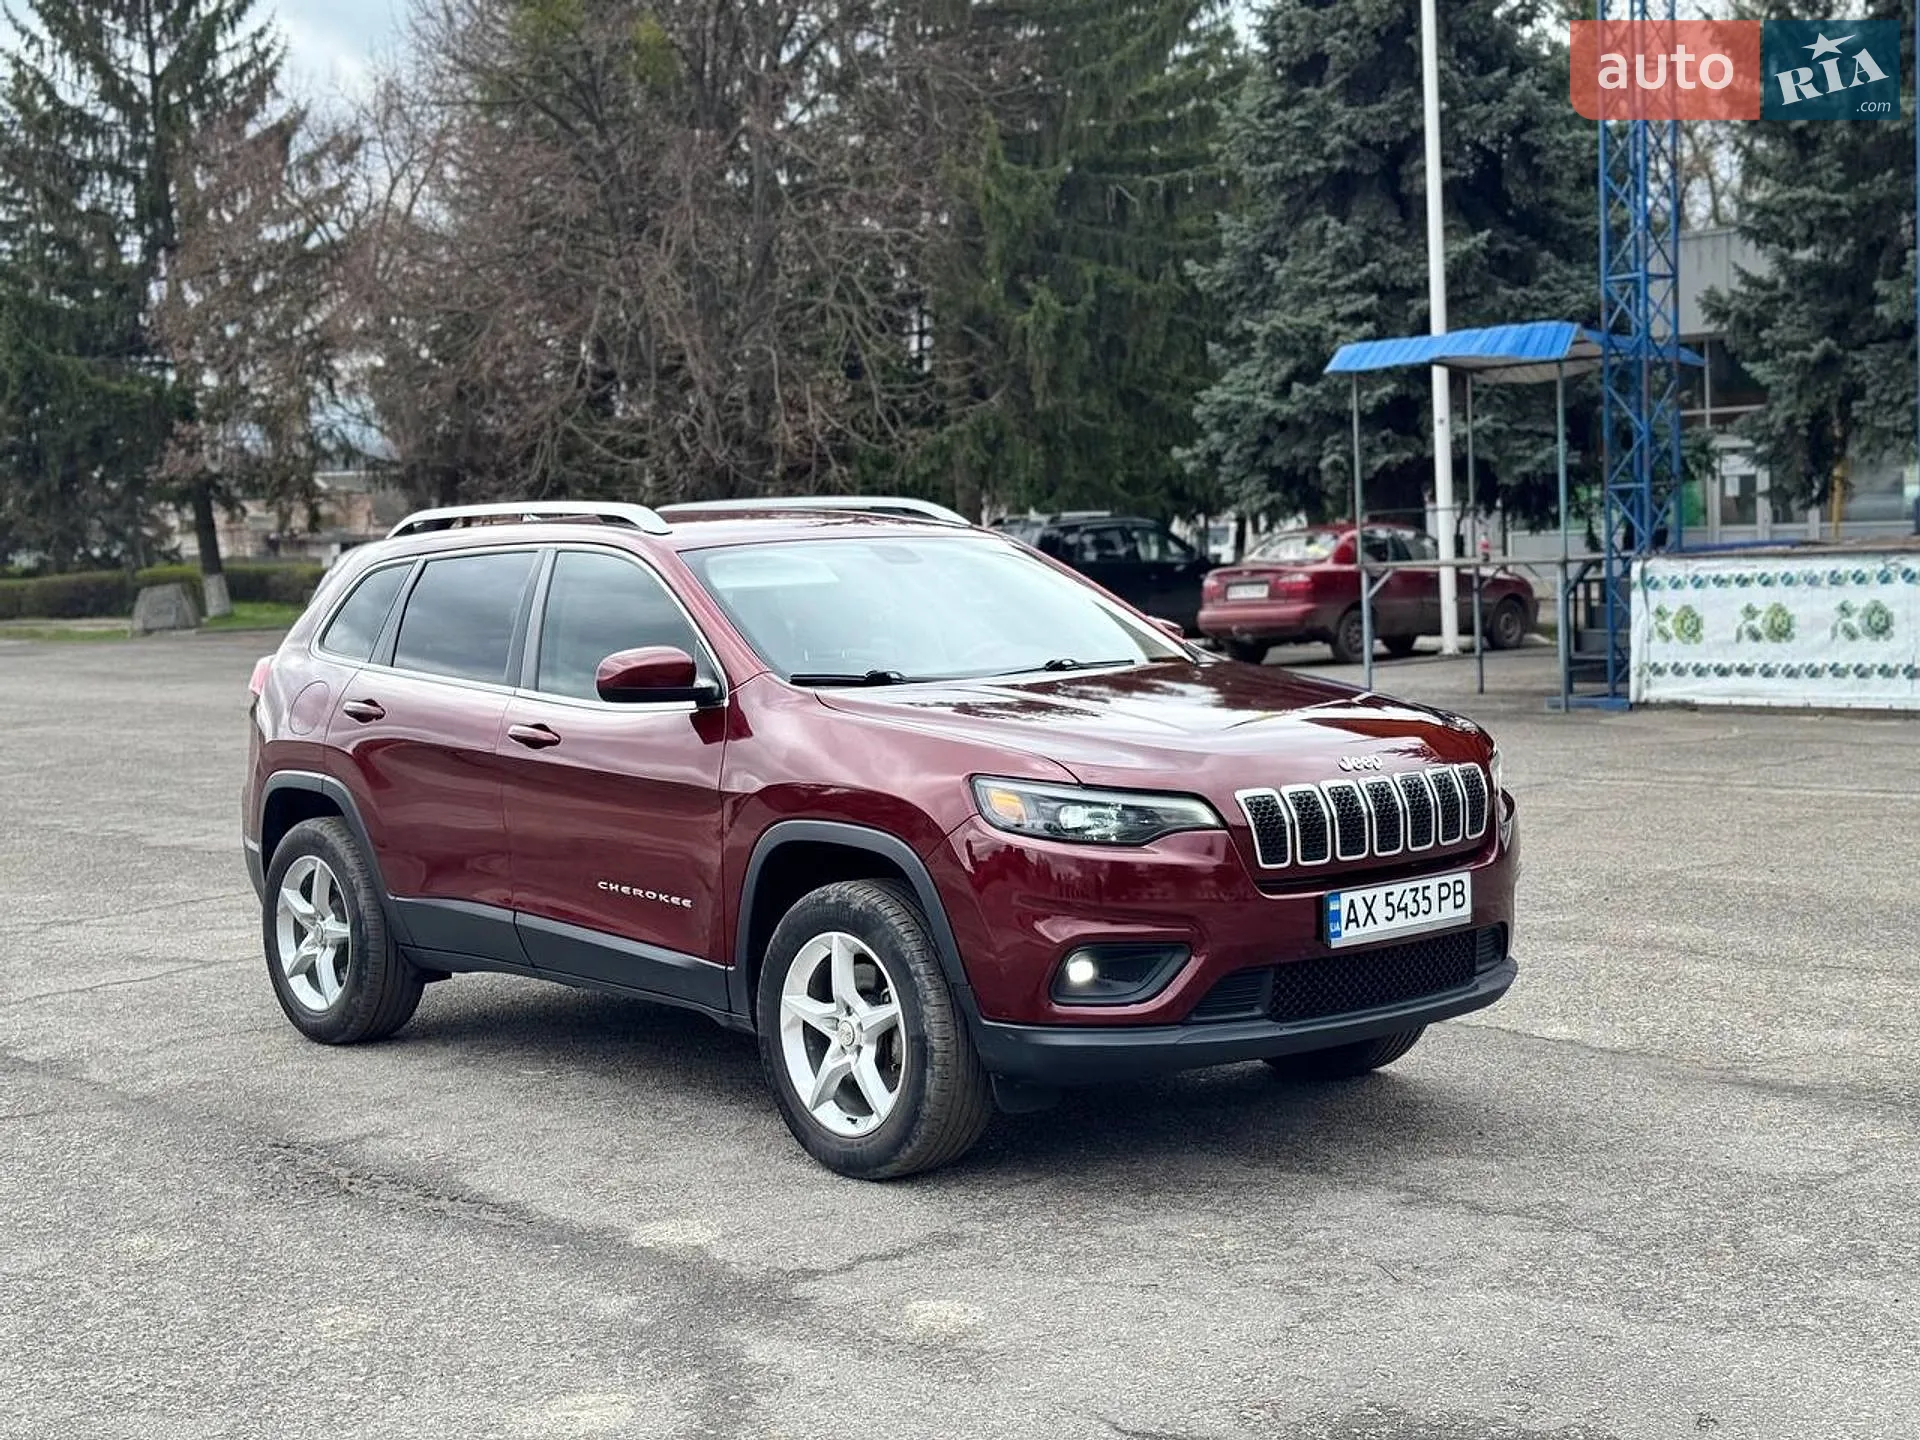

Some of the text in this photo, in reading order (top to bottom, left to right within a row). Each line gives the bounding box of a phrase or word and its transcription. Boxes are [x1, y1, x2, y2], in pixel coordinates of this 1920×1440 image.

[1337, 755, 1383, 772] Jeep
[597, 880, 693, 909] CHEROKEE
[1344, 879, 1466, 931] AX 5435 PB
